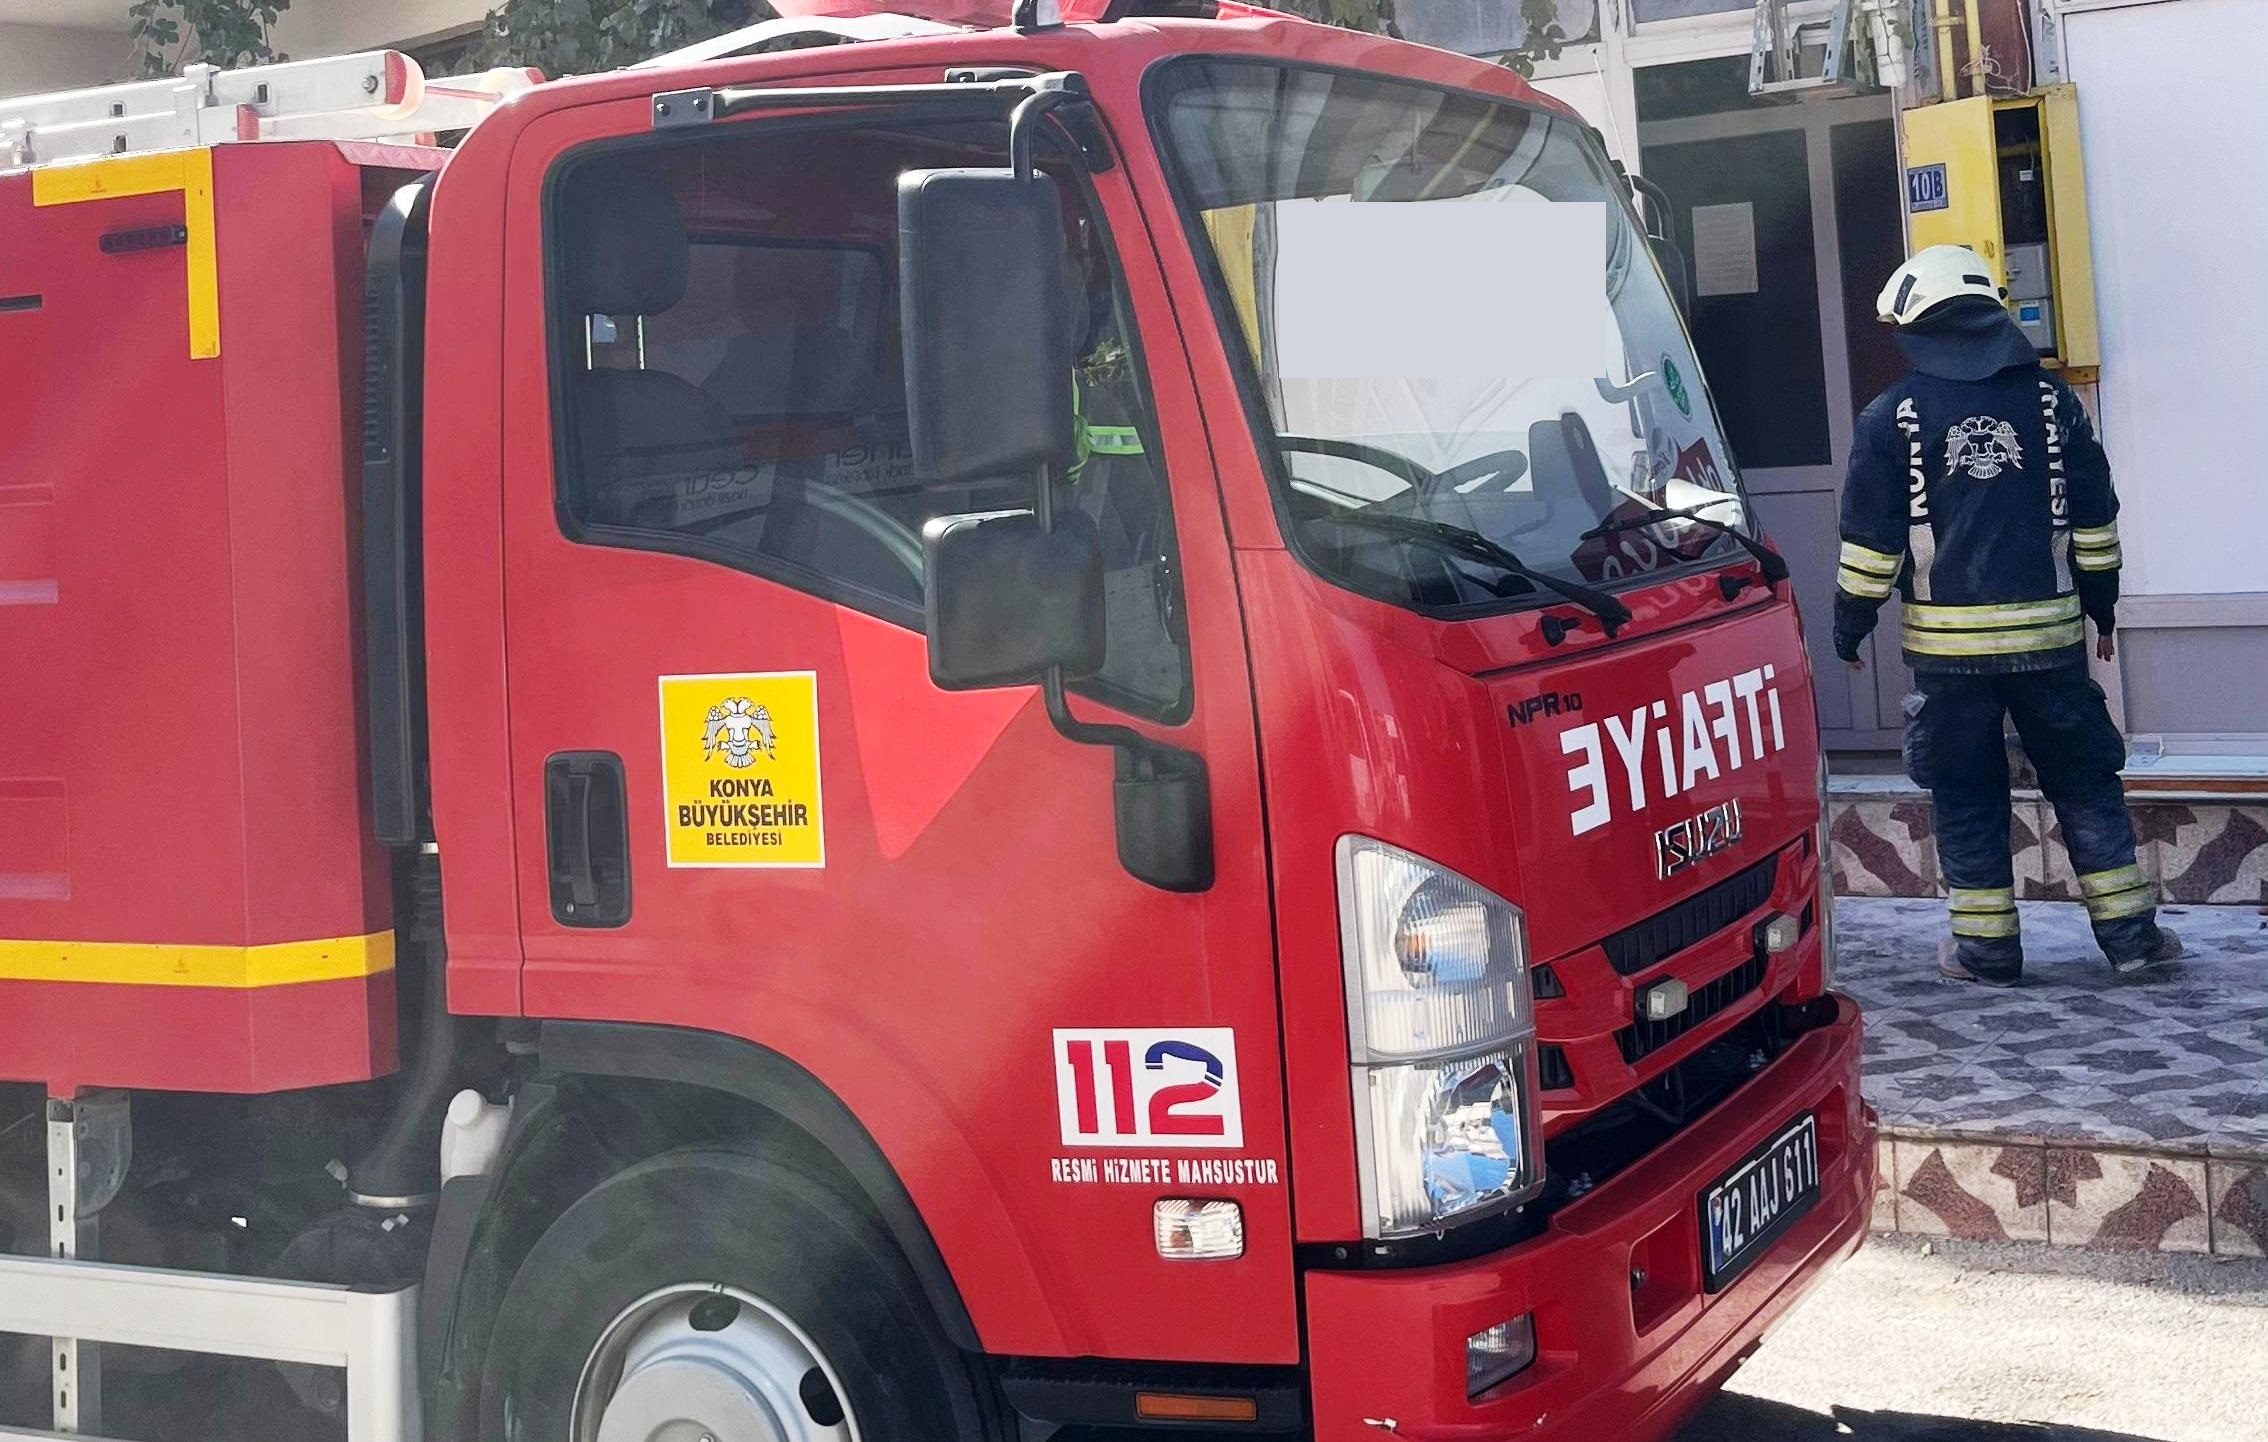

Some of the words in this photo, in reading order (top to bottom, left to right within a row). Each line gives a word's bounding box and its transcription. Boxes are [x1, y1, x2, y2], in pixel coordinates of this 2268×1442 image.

[1507, 692, 1562, 728] NPR
[1563, 693, 1583, 712] 10
[710, 779, 774, 798] KONYA
[678, 799, 808, 830] BÜYÜKŞEHİR
[706, 829, 782, 846] BELEDİYESİ
[1654, 796, 1744, 881] ISUZU
[1066, 1040, 1225, 1136] 112
[1176, 1158, 1279, 1184] MAHSUSTUR
[1722, 1187, 1744, 1256] 42
[1750, 1157, 1779, 1235] AAJ
[1783, 1131, 1812, 1202] 611
